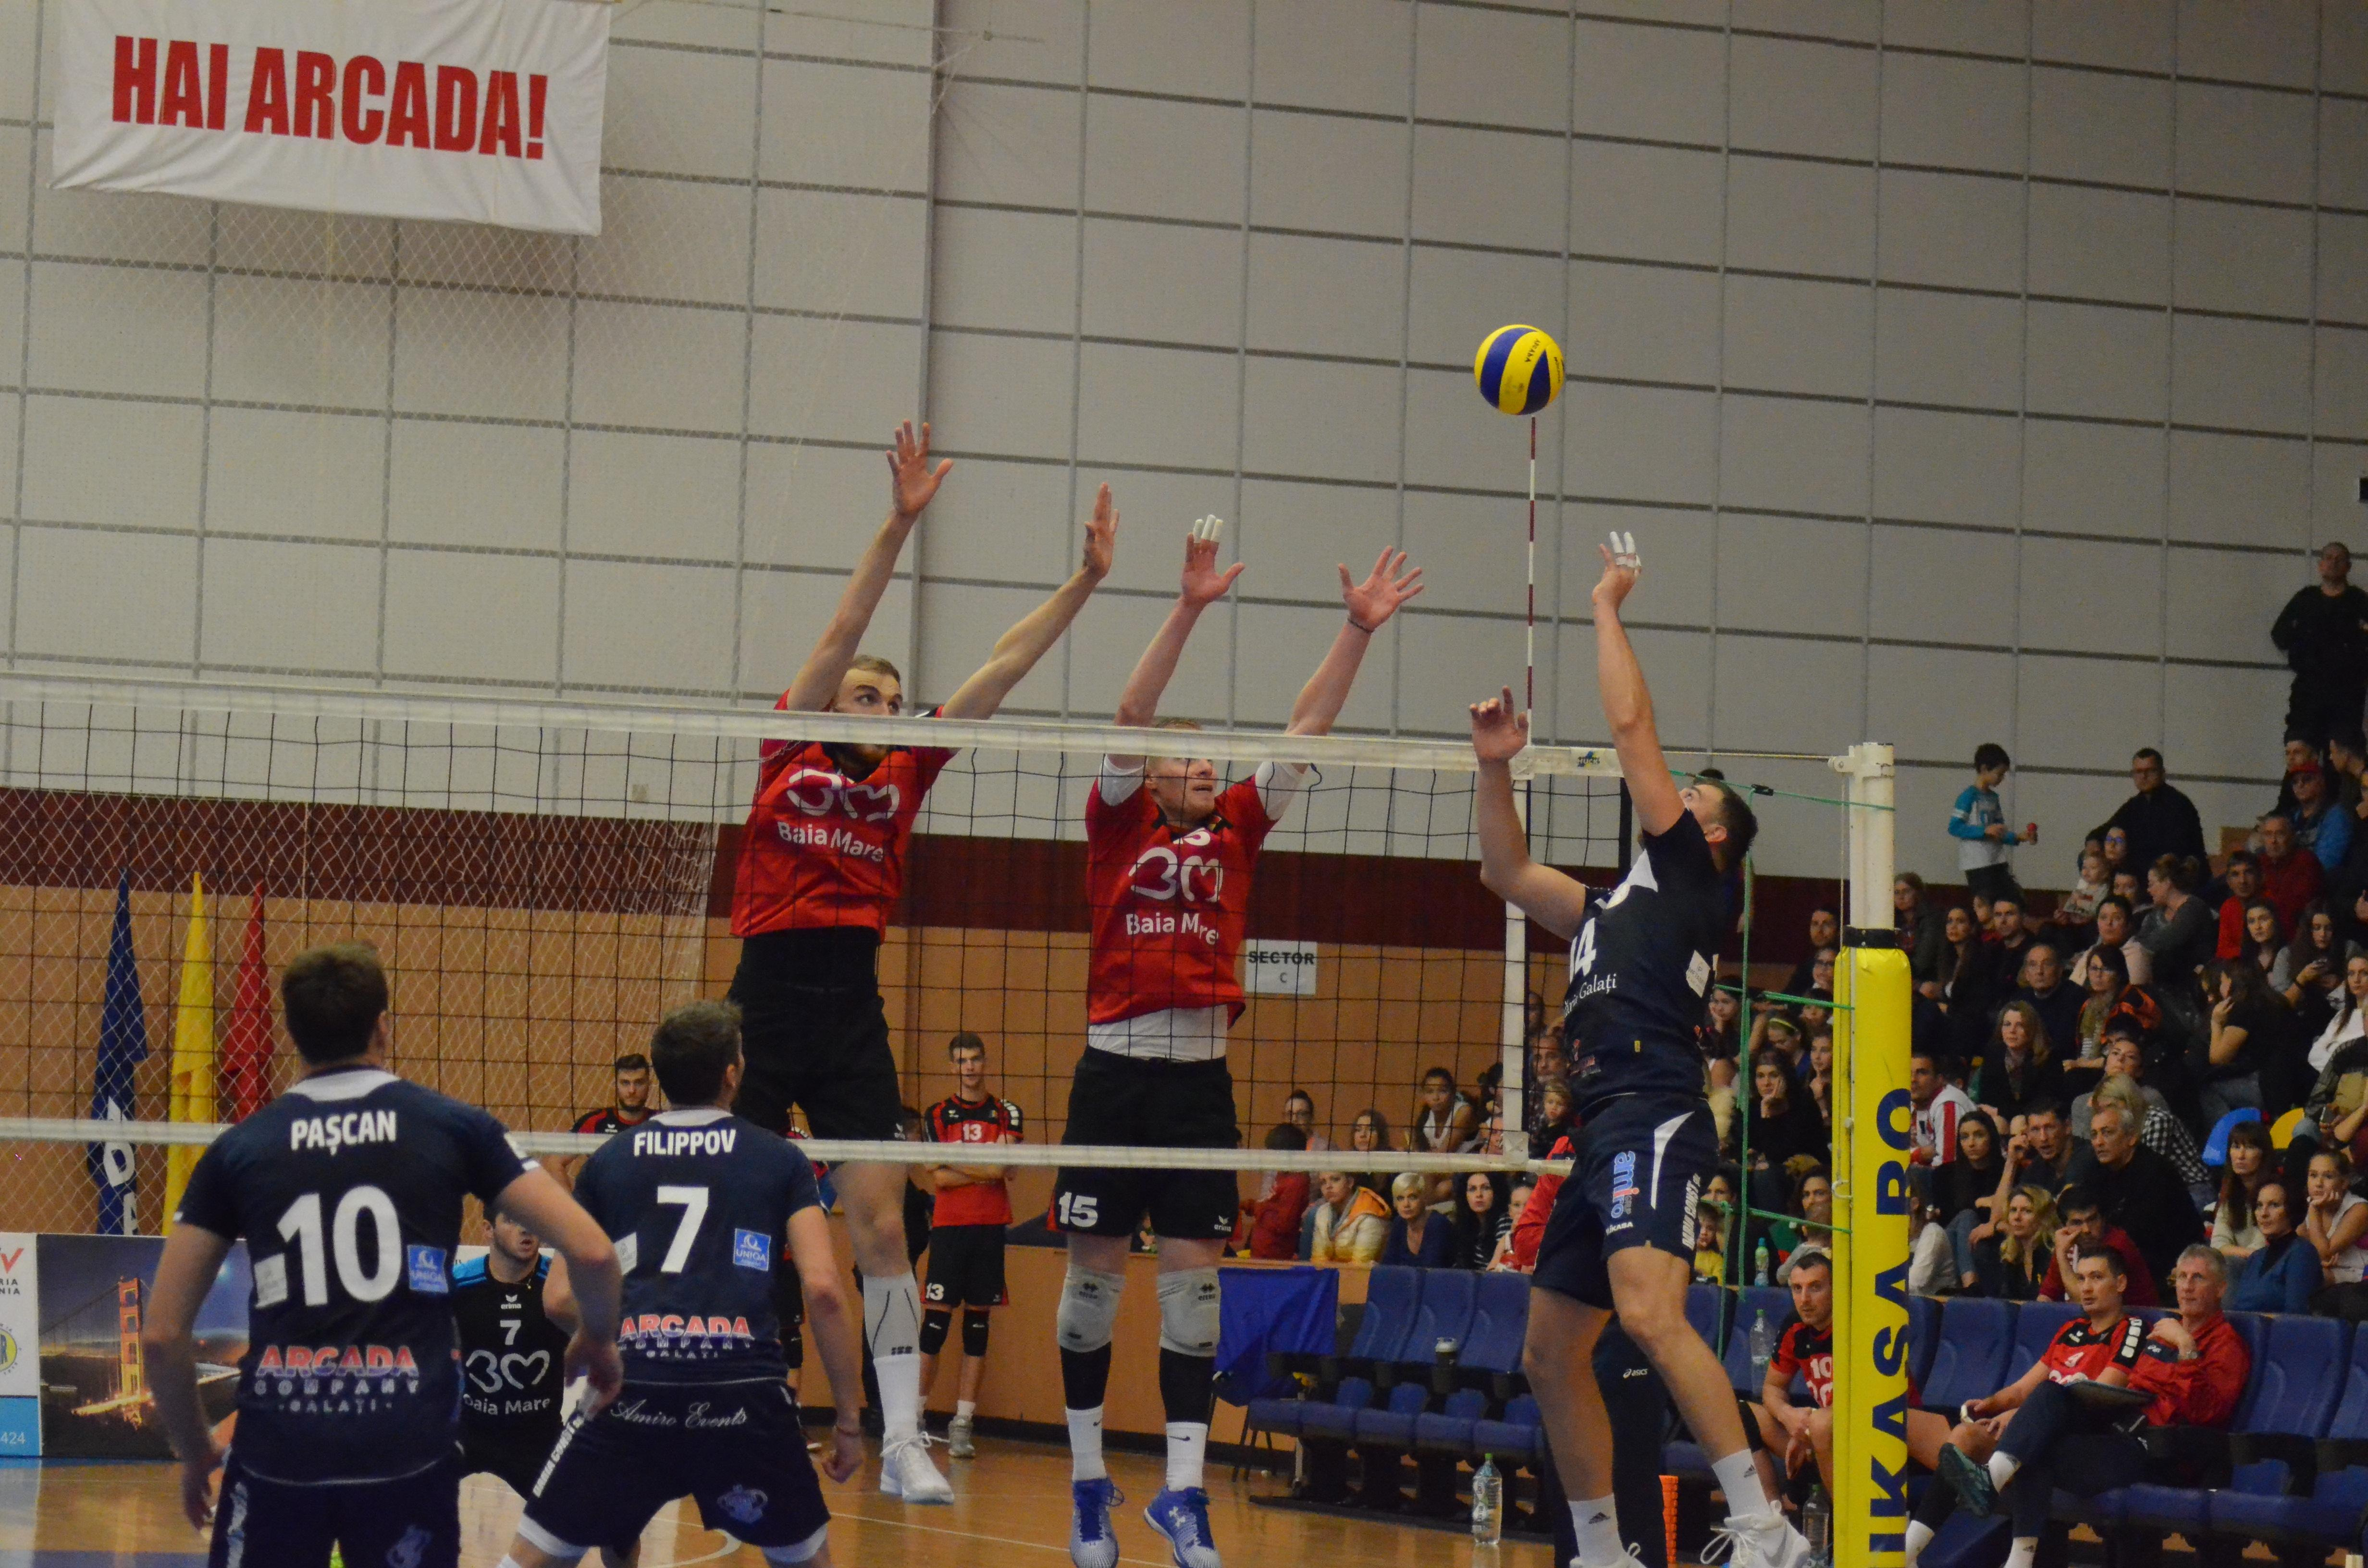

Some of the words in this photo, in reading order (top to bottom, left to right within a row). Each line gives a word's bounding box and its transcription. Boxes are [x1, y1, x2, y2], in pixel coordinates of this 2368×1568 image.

[113, 35, 229, 131] HAI
[244, 46, 548, 160] ARCADA!
[777, 821, 827, 845] Baia
[830, 829, 883, 862] Mare
[1126, 912, 1175, 936] Baia
[1181, 912, 1219, 944] Mre
[1248, 951, 1315, 965] SECTOR
[1570, 917, 1596, 984] 14
[1280, 972, 1287, 983] C
[1579, 973, 1617, 998] Galați
[291, 1110, 397, 1155] PAȘCAN
[634, 1129, 736, 1156] FILIPPOV
[963, 1123, 983, 1141] 13
[1611, 1151, 1639, 1218] amiro
[1059, 1191, 1098, 1227] 15
[657, 1186, 709, 1274] 7
[1214, 1224, 1232, 1232] erima
[277, 1185, 402, 1307] 10
[736, 1249, 768, 1263] UNIQA
[926, 1283, 943, 1300] 13
[500, 1320, 521, 1345] 7
[619, 1314, 755, 1340] ARCADA
[255, 1345, 419, 1377] ARCADA
[1631, 1368, 1648, 1377] asics
[255, 1379, 419, 1395] COMPANY
[505, 1397, 551, 1415] Mare
[610, 1399, 676, 1426] Amiro
[685, 1402, 748, 1428] Events
[1869, 1259, 1909, 1568] IKASA
